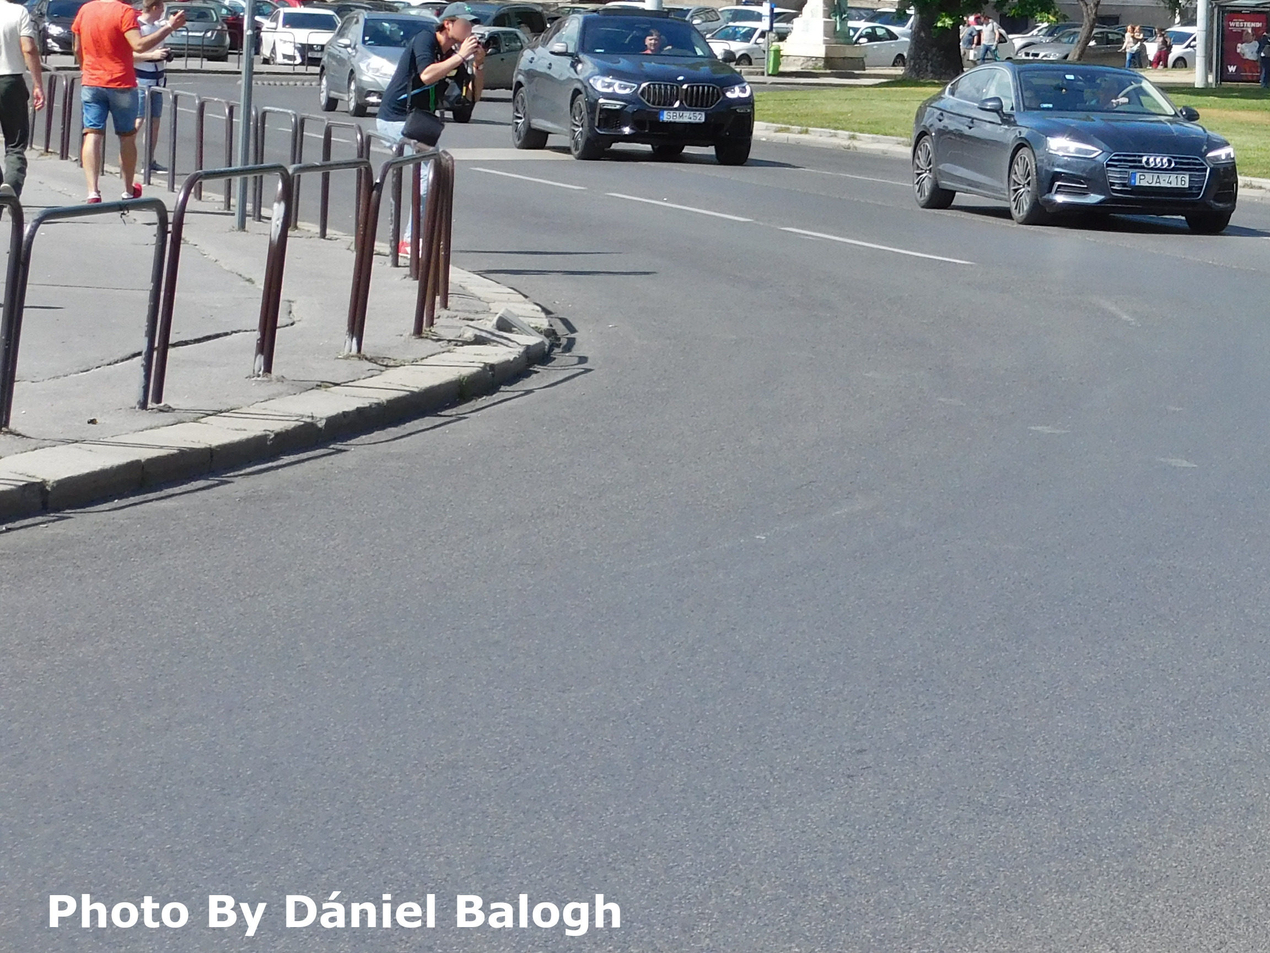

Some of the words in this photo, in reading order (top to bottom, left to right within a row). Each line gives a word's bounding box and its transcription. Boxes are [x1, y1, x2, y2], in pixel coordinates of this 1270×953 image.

[1227, 65, 1237, 73] W
[666, 111, 703, 121] SBM-452
[1138, 174, 1186, 186] PJA-416
